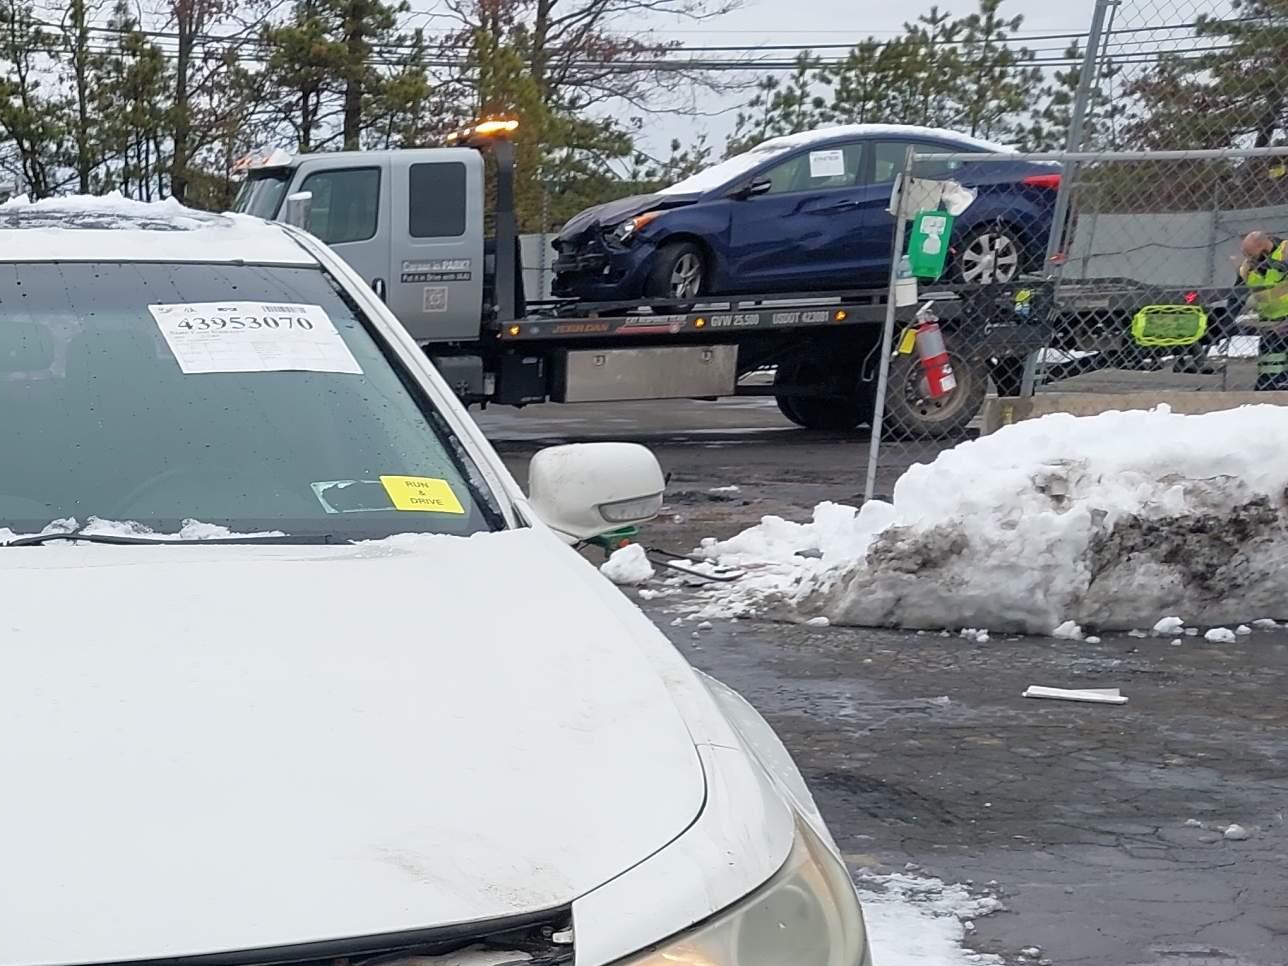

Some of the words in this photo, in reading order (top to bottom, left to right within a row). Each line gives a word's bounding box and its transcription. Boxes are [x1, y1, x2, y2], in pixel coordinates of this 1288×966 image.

[177, 316, 314, 331] 43953070
[711, 314, 732, 327] GVW
[772, 312, 801, 325] USDOT
[404, 480, 430, 489] RUN
[409, 497, 445, 506] DRIVE
